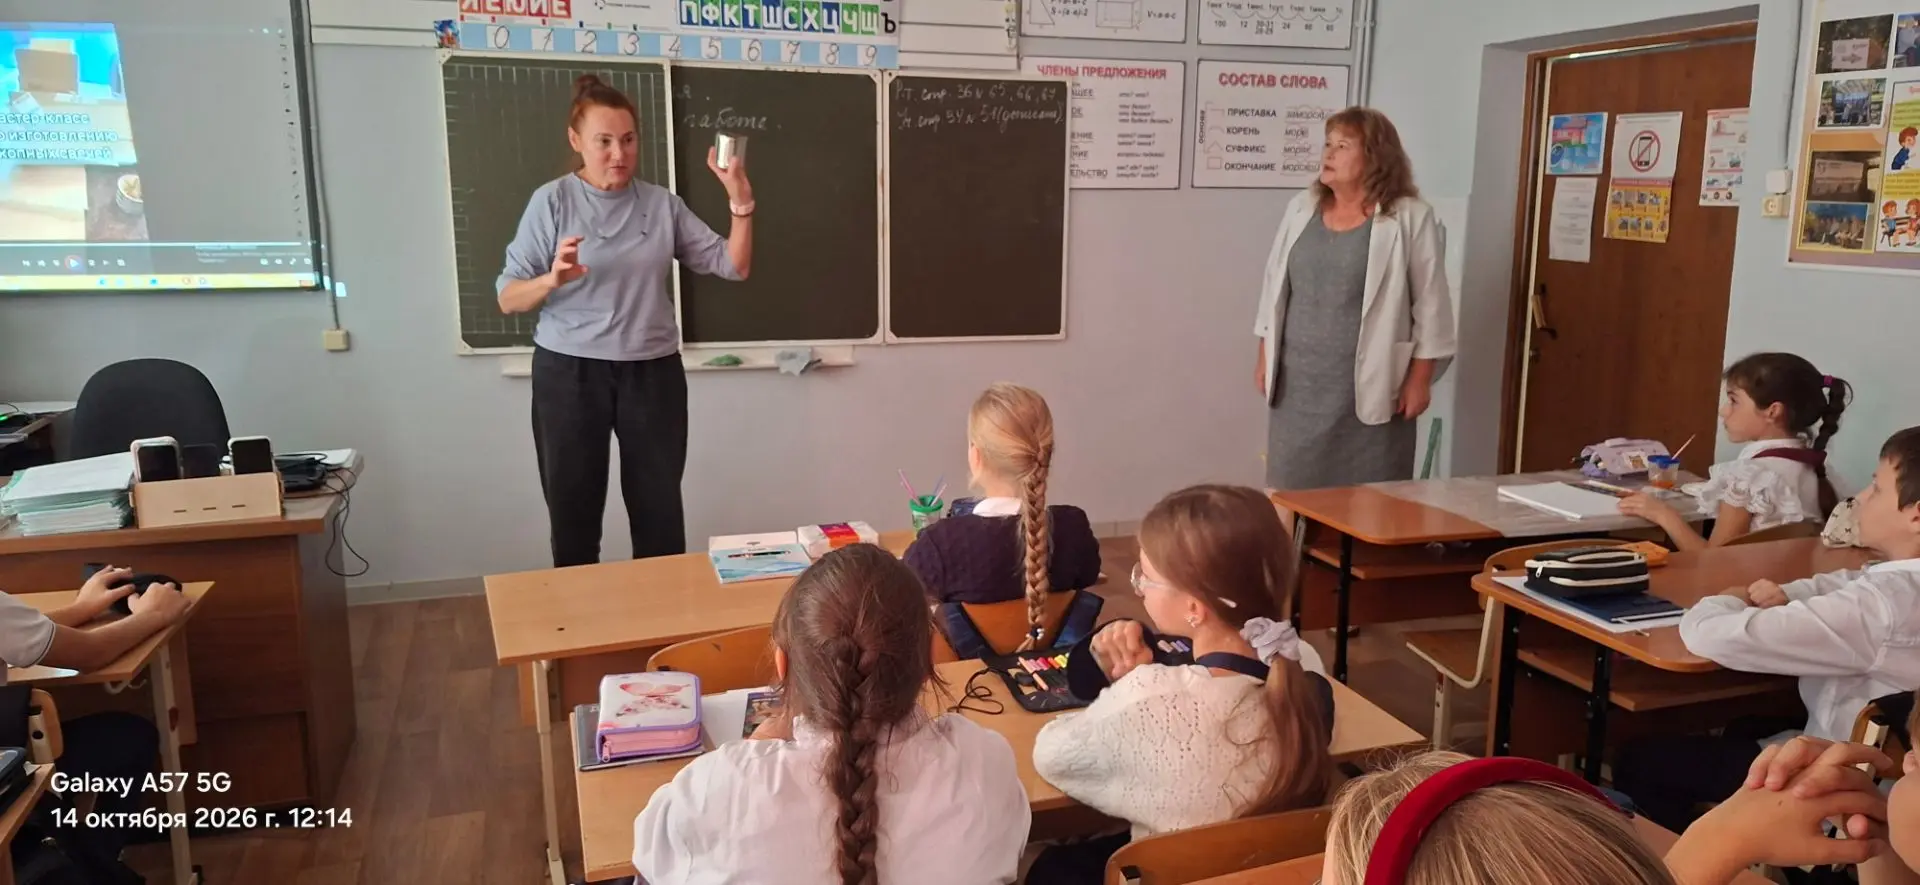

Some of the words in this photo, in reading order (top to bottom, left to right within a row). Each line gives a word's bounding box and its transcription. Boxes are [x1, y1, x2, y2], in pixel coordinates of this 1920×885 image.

[494, 25, 510, 49] 0
[543, 28, 555, 51] 1
[581, 30, 597, 53] 2
[623, 32, 640, 55] 3
[668, 36, 682, 58] 4
[707, 37, 723, 60] 5
[747, 38, 763, 61] 6
[786, 40, 801, 63] 7
[825, 43, 841, 65] 8
[863, 45, 878, 66] 9
[1037, 64, 1079, 77] ЧЛЕНЫ
[1082, 66, 1167, 80] ПРЕДЛОЖЕНИЯ
[1218, 72, 1276, 88] СОСТАВ
[1280, 74, 1329, 90] СЛОВА
[1227, 108, 1277, 118] ПРИСТАВКА
[8, 130, 120, 142] изготовлению
[1226, 127, 1261, 136] КОРЕНЬ
[0, 148, 59, 160] копных
[1225, 144, 1267, 154] СУФФИКС
[1224, 161, 1277, 172] ОКОНЧАНИЕ
